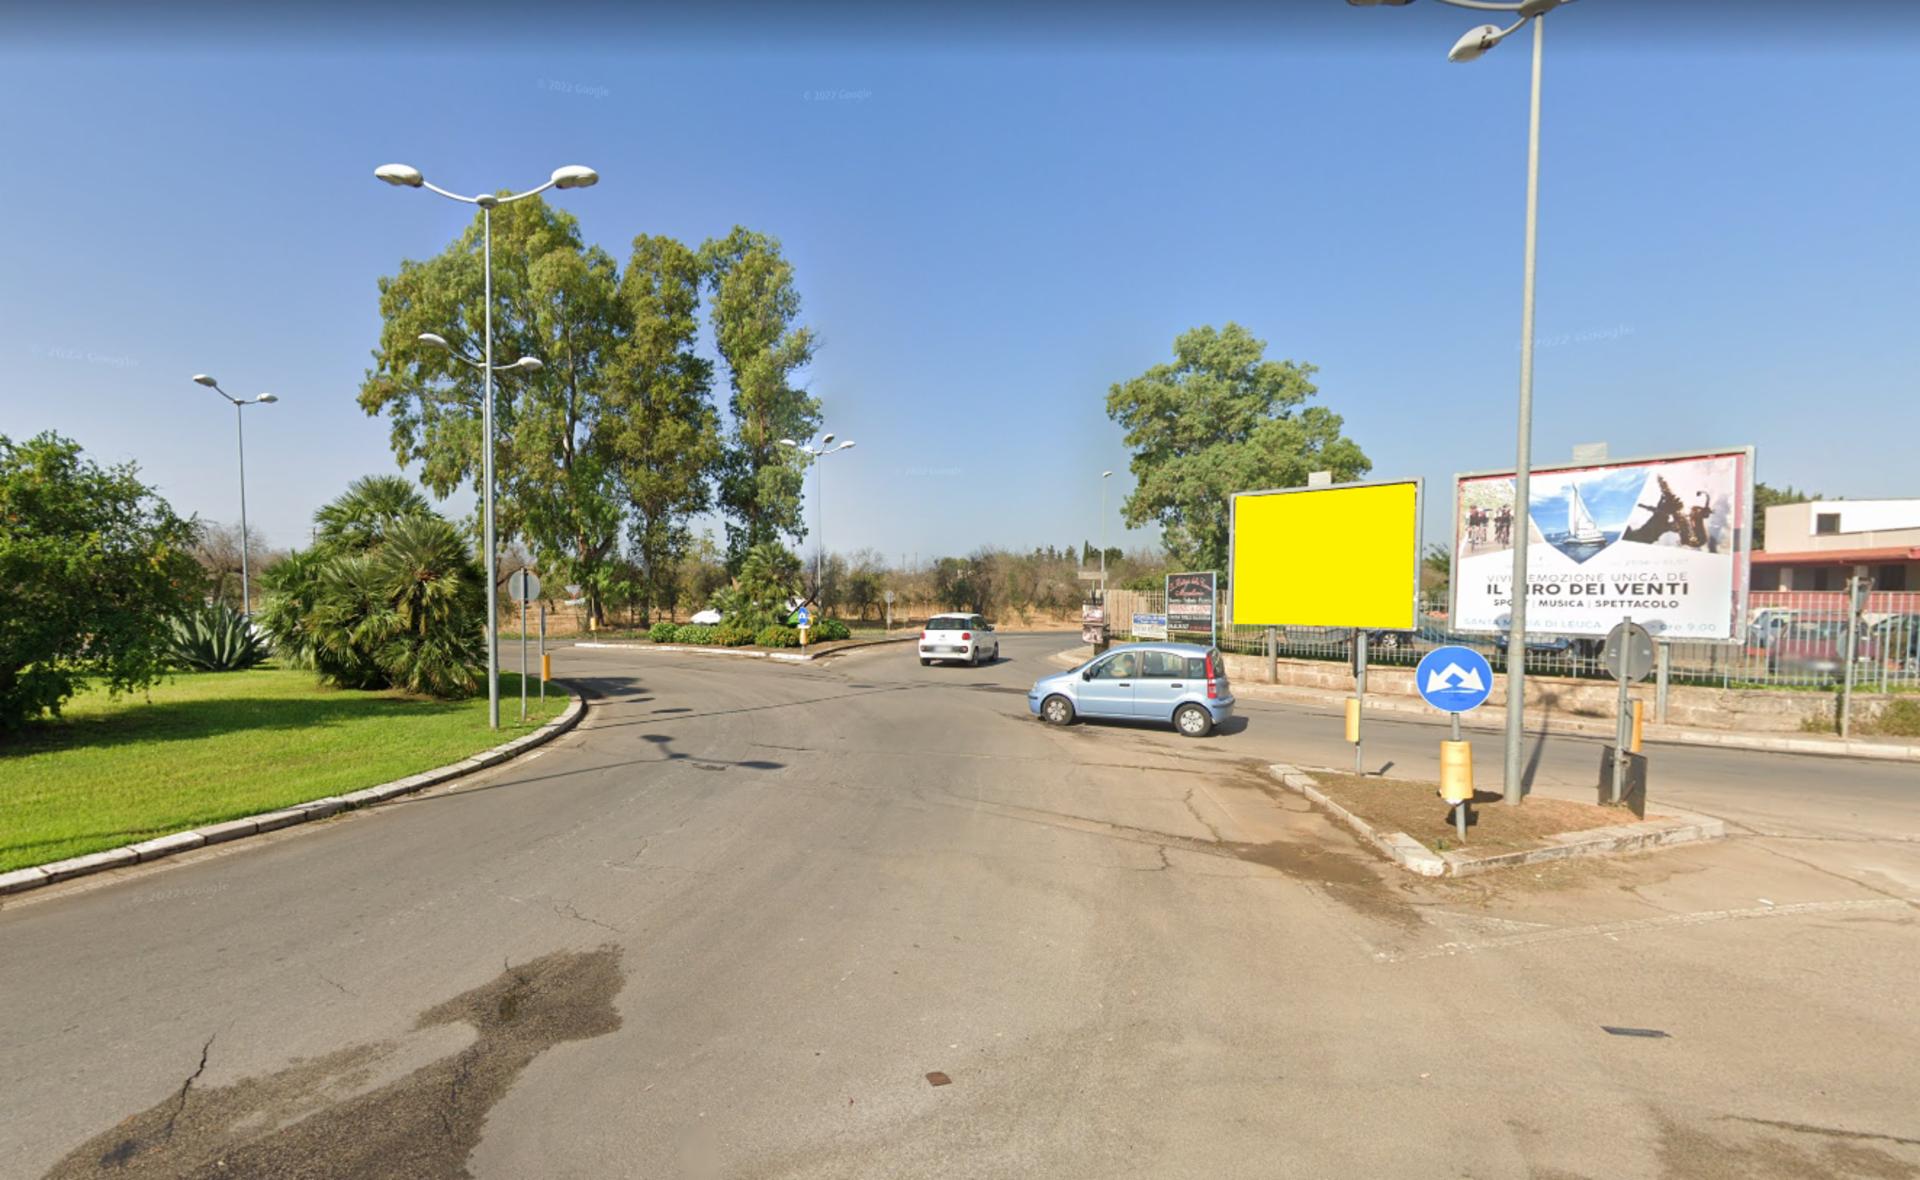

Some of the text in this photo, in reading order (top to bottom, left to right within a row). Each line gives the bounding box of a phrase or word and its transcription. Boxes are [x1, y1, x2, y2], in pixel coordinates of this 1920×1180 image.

[1487, 574, 1511, 583] VIVI
[1611, 572, 1659, 582] UNICA
[1667, 572, 1688, 581] DE
[1487, 583, 1688, 595] IL IRO DEI VENTI
[1493, 599, 1528, 607] SPO
[1595, 600, 1679, 608] SPETTACOLO
